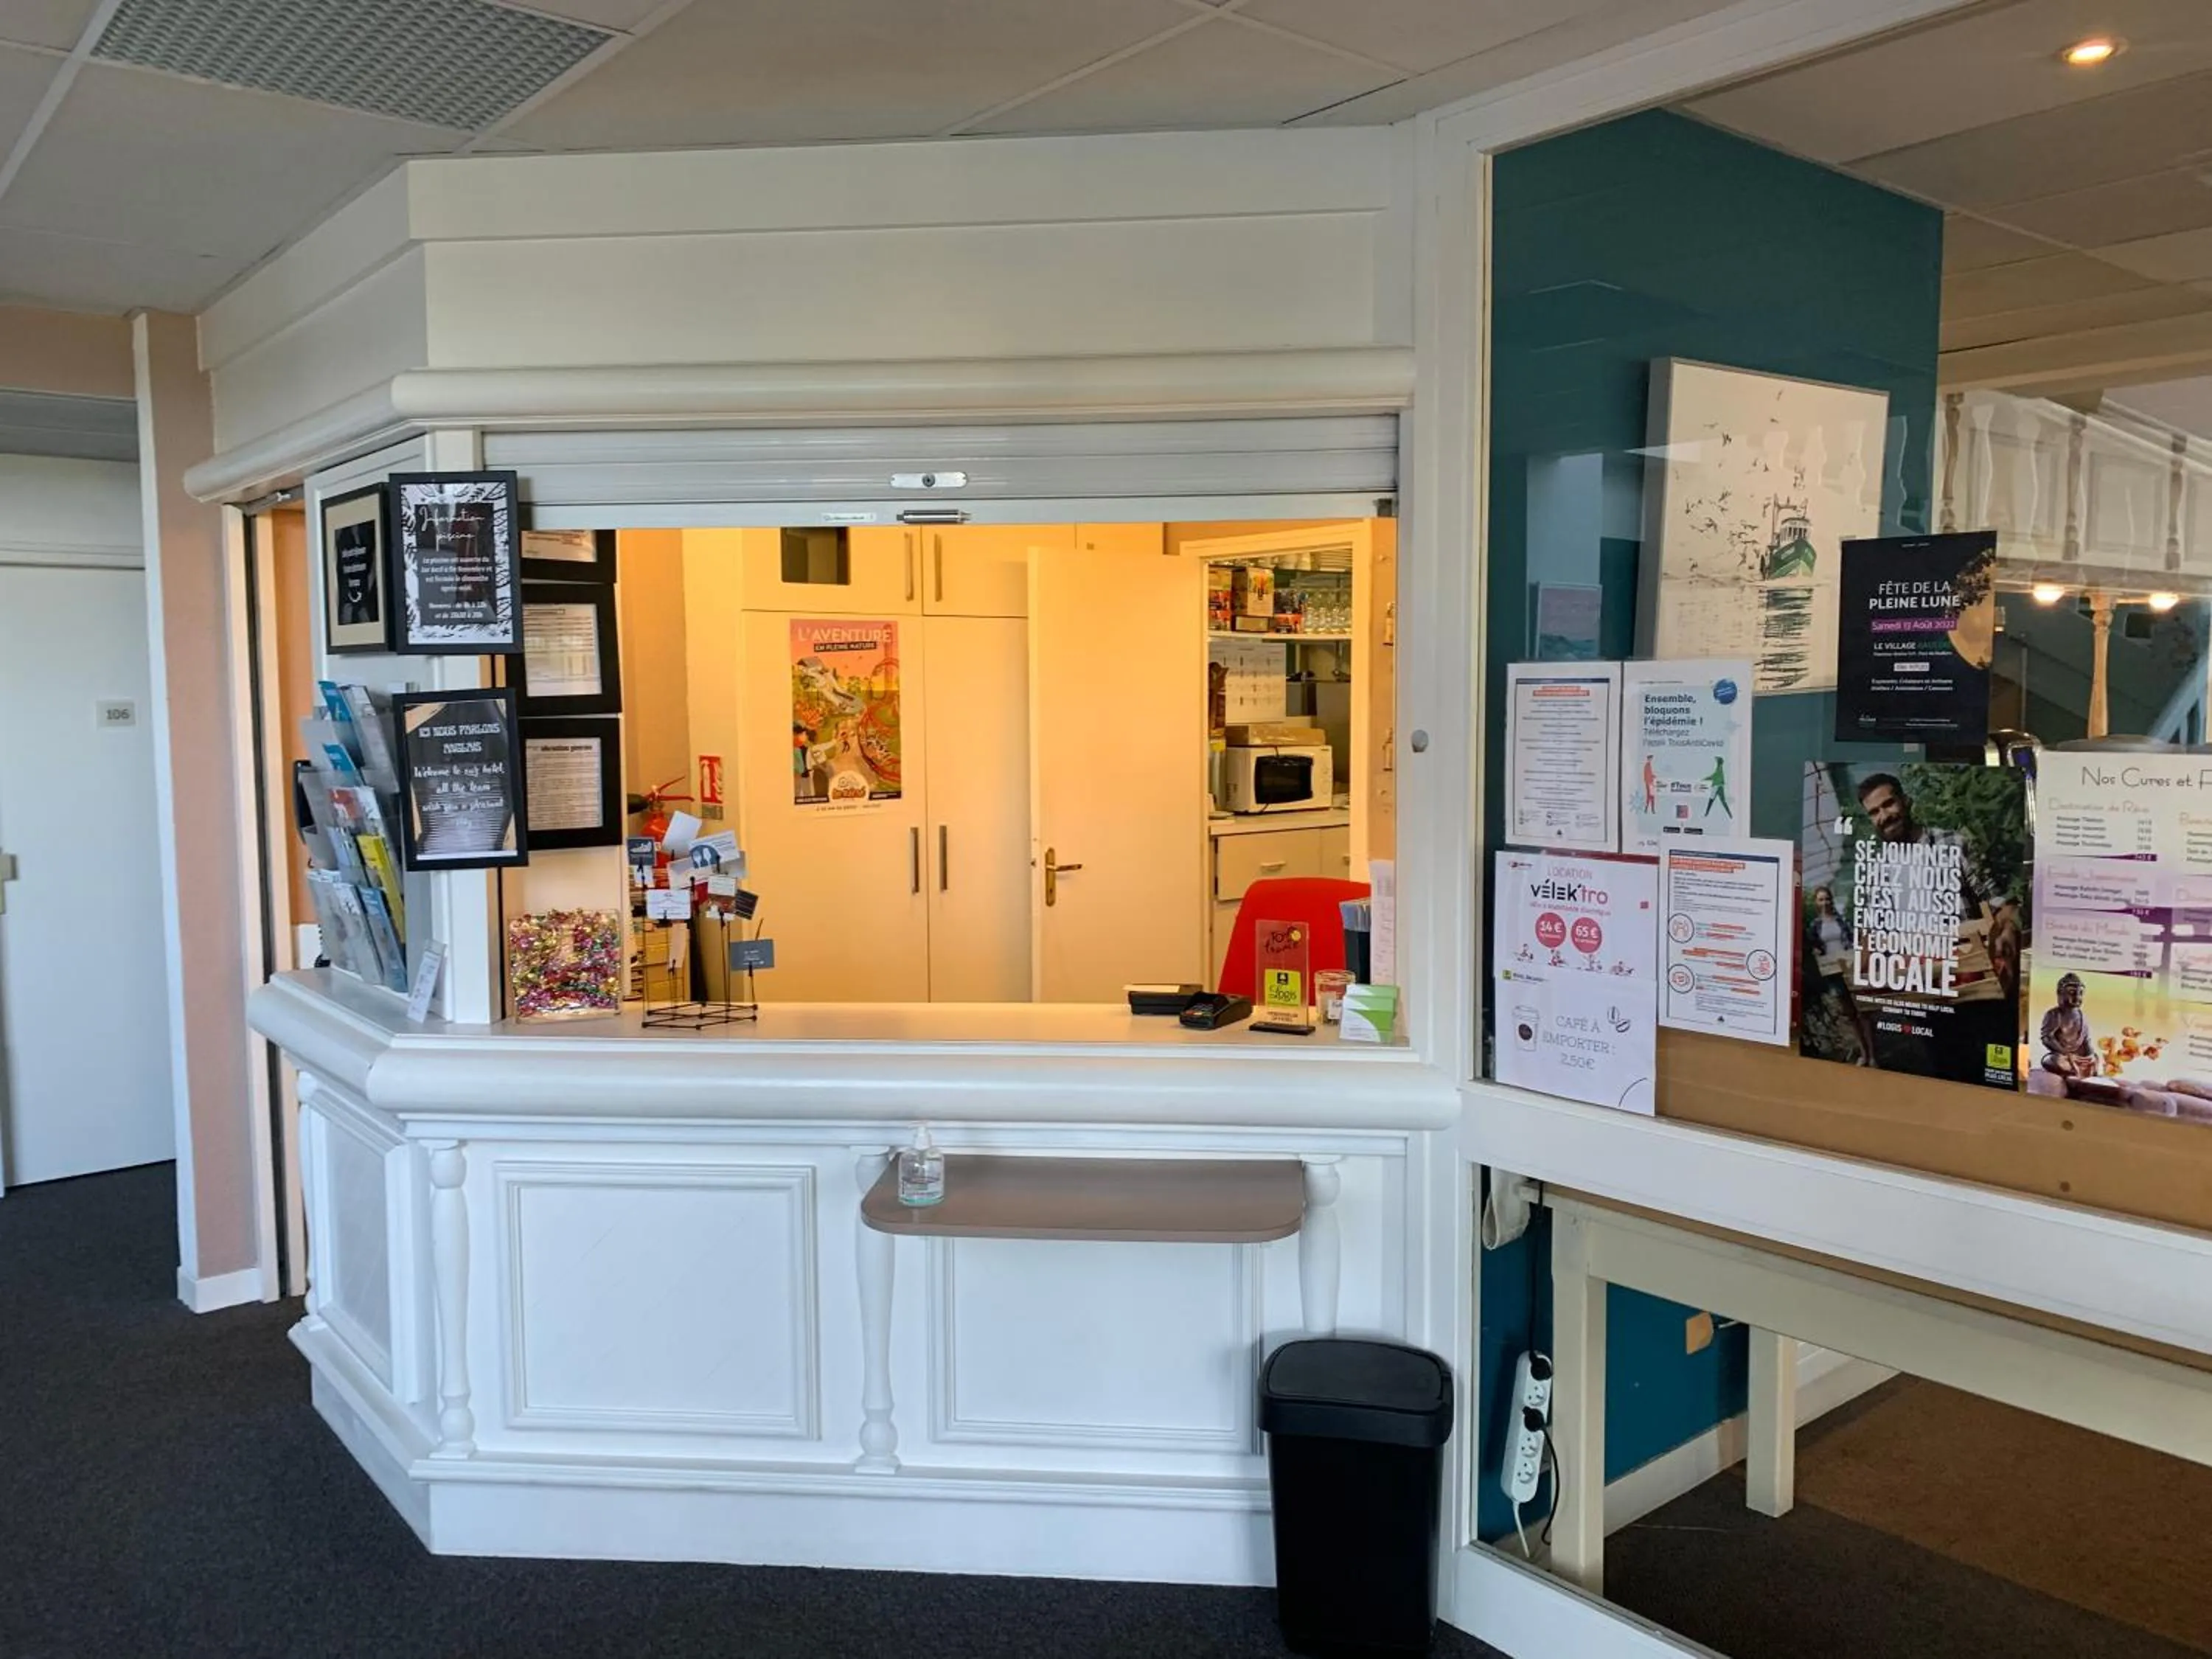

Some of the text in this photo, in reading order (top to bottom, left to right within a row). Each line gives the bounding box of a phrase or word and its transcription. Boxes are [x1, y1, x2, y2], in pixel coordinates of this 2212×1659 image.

[1879, 580, 1950, 595] FÊTE DE LA
[1869, 595, 1961, 610] PLEINE LUNE
[1872, 622, 1902, 630] Samedi
[798, 627, 892, 642] L'AVENTURE
[1644, 694, 1697, 703] Ensemble,
[106, 709, 131, 720] 106
[1644, 706, 1691, 716] bloquons
[1644, 716, 1697, 727] l'épidémie
[2082, 766, 2115, 786] Nos
[2121, 768, 2171, 787] Cures
[2176, 773, 2193, 786] et
[1854, 835, 1961, 868] SÉJOURNER
[1548, 866, 1593, 880] LOCATION
[1854, 862, 1961, 892] CHEZ NOUS
[1854, 885, 1961, 914] C'EST AUSSI
[1854, 908, 1961, 937] ENCOURAGER
[1853, 928, 1959, 960] L'ÉCONOMIE
[1853, 951, 1959, 997] LOCALE
[1555, 1016, 1587, 1032] CAFÉ
[1877, 1021, 1934, 1037] #LOGIS LOCAL
[1542, 1031, 1610, 1054] EMPORTER
